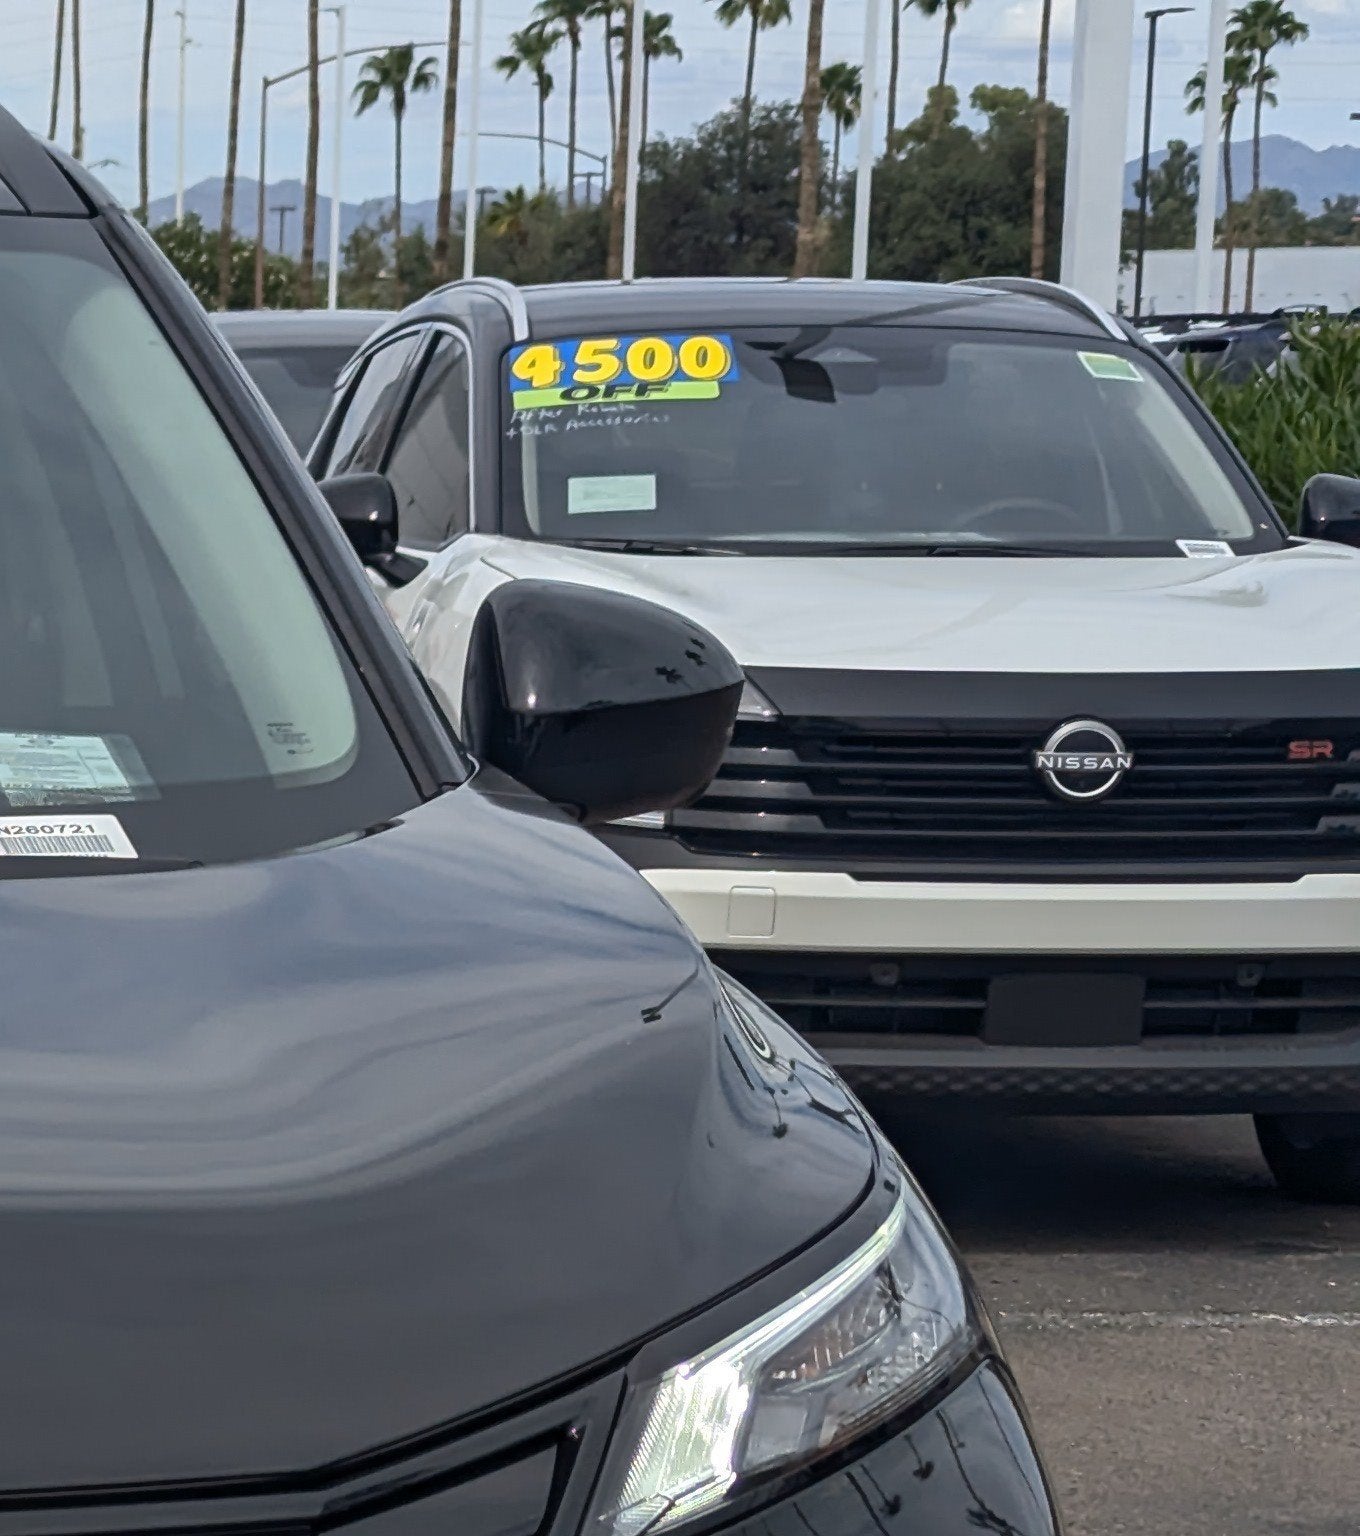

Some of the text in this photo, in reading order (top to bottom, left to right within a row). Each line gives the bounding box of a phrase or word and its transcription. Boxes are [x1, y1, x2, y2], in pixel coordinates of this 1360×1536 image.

[511, 335, 732, 388] 4500
[559, 381, 672, 402] OFF
[1287, 740, 1335, 759] SR
[1036, 753, 1132, 770] NISSAN
